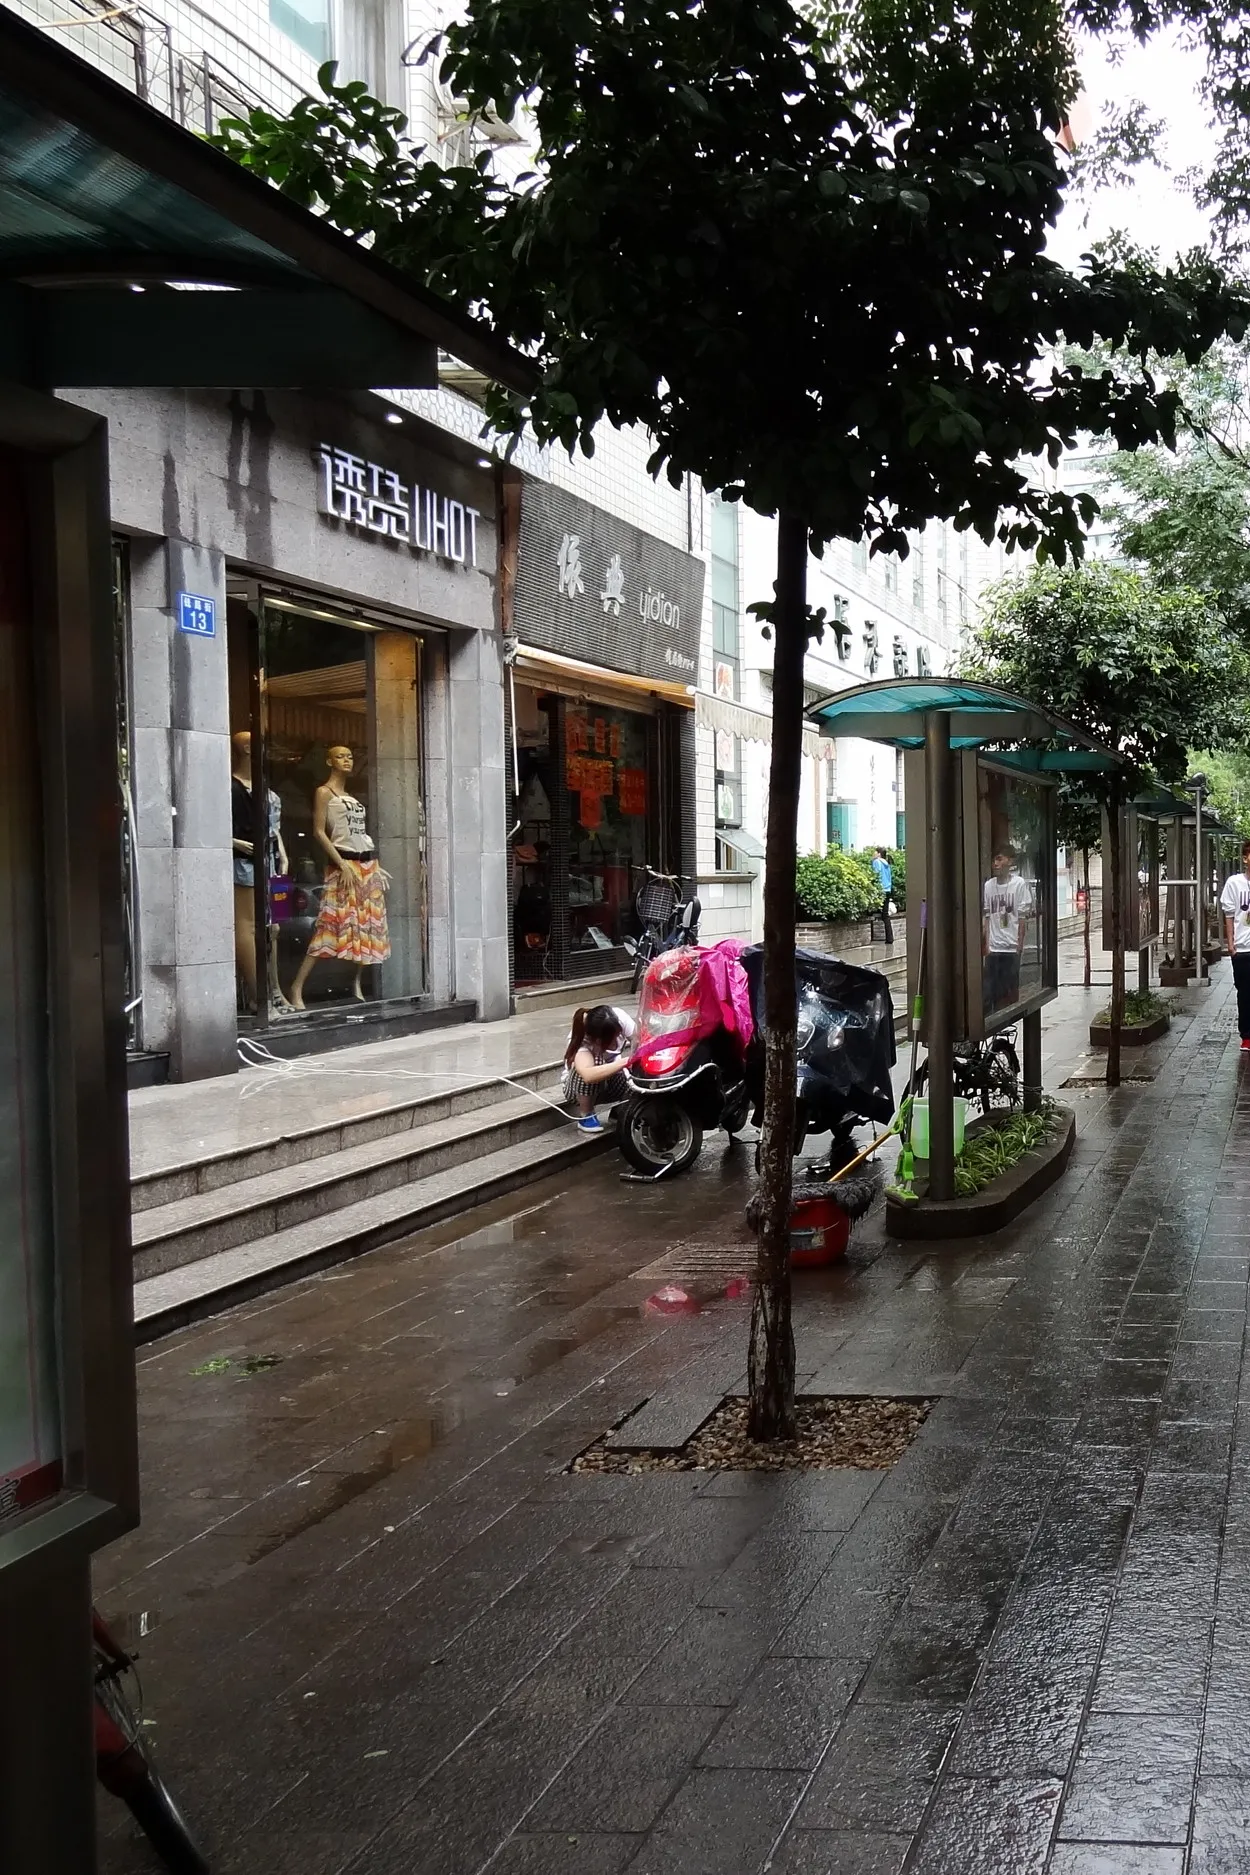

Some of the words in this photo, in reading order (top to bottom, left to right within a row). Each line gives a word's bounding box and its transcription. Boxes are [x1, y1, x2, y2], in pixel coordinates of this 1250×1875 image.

[414, 482, 481, 567] UHOT
[189, 610, 207, 630] 13
[639, 587, 680, 629] yidian
